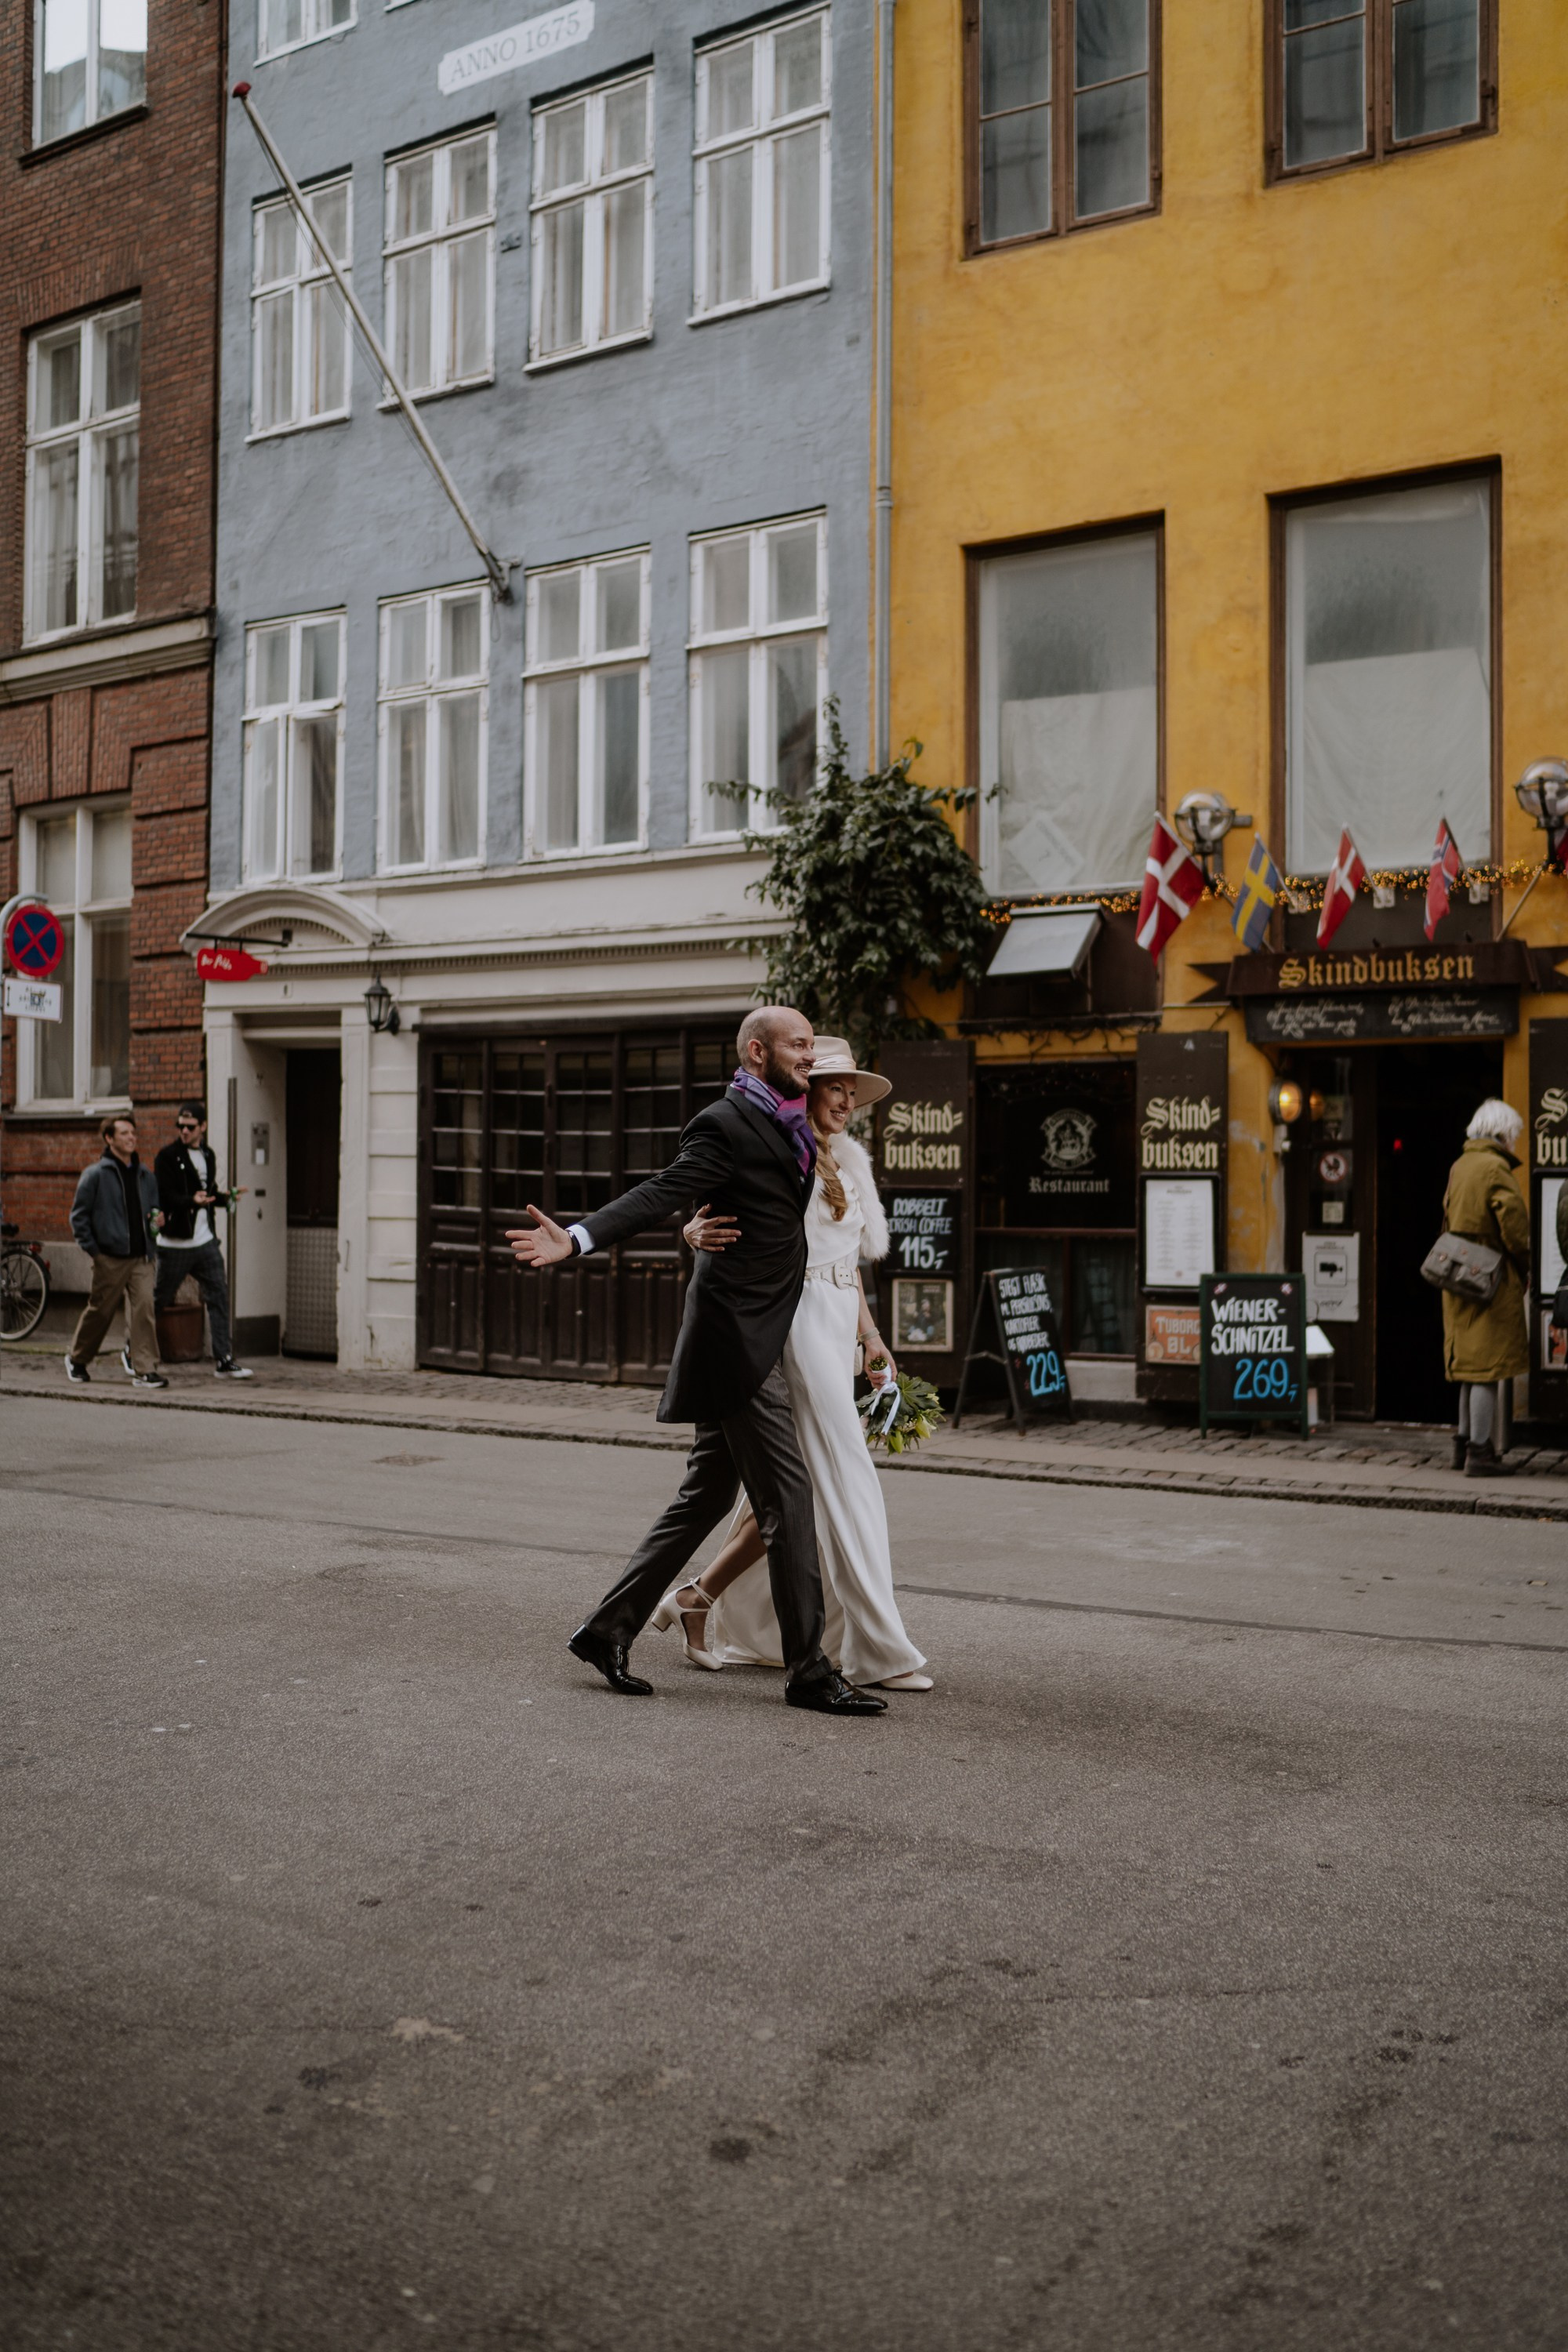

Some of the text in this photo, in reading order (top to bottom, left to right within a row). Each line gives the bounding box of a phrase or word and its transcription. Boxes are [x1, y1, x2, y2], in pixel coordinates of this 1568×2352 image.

[451, 10, 580, 82] ANNO 1675
[1278, 949, 1475, 989] Skindbuksen
[884, 1138, 961, 1170] buksen
[1142, 1134, 1218, 1169] buksen
[1029, 1176, 1110, 1192] Restaurant
[893, 1198, 948, 1217] DOBBELT
[918, 1217, 953, 1234] COFFEE
[999, 1276, 1022, 1299] STEGT
[1167, 1335, 1191, 1355] ØL
